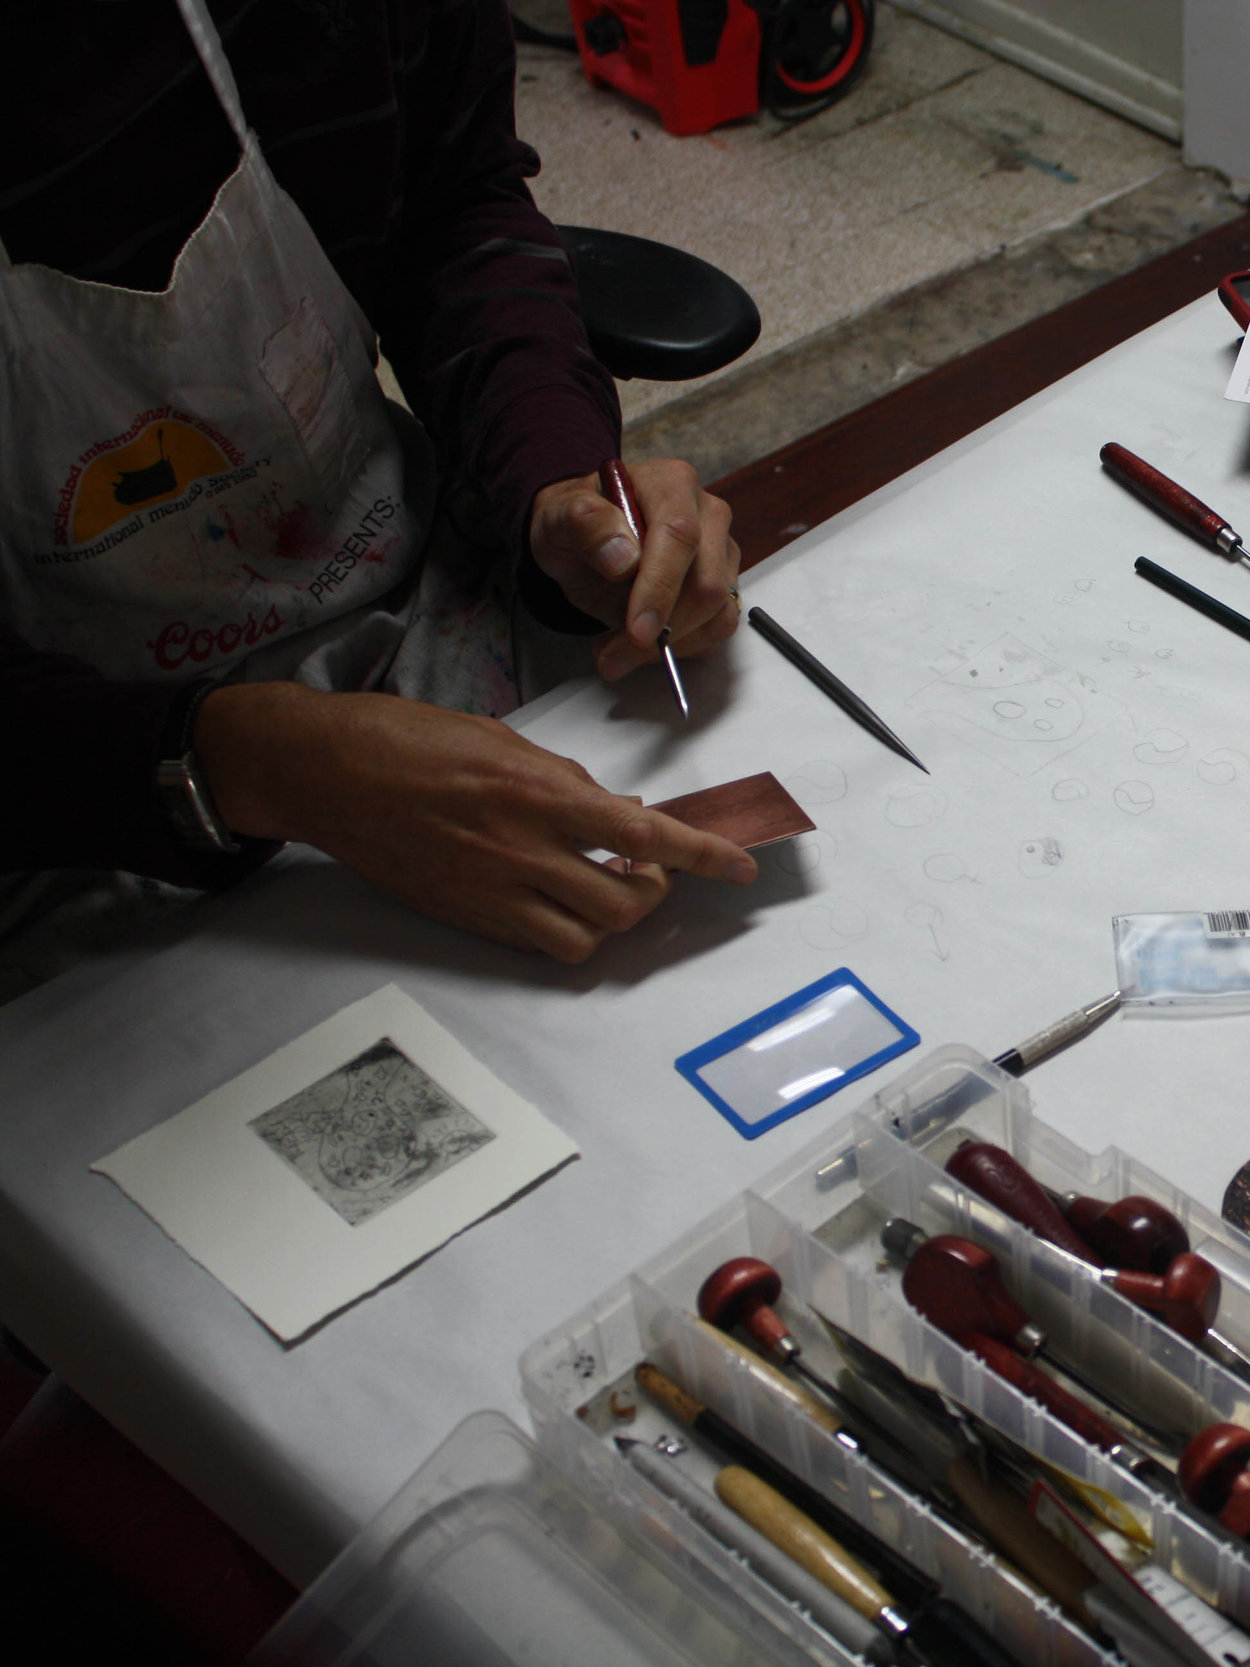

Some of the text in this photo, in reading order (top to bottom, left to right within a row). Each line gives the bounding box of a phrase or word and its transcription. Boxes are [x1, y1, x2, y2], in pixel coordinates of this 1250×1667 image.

[34, 514, 145, 565] international
[147, 483, 203, 524] menudo
[53, 464, 83, 546] sociedad
[308, 495, 402, 605] PRESENTS:
[145, 603, 288, 671] Coors
